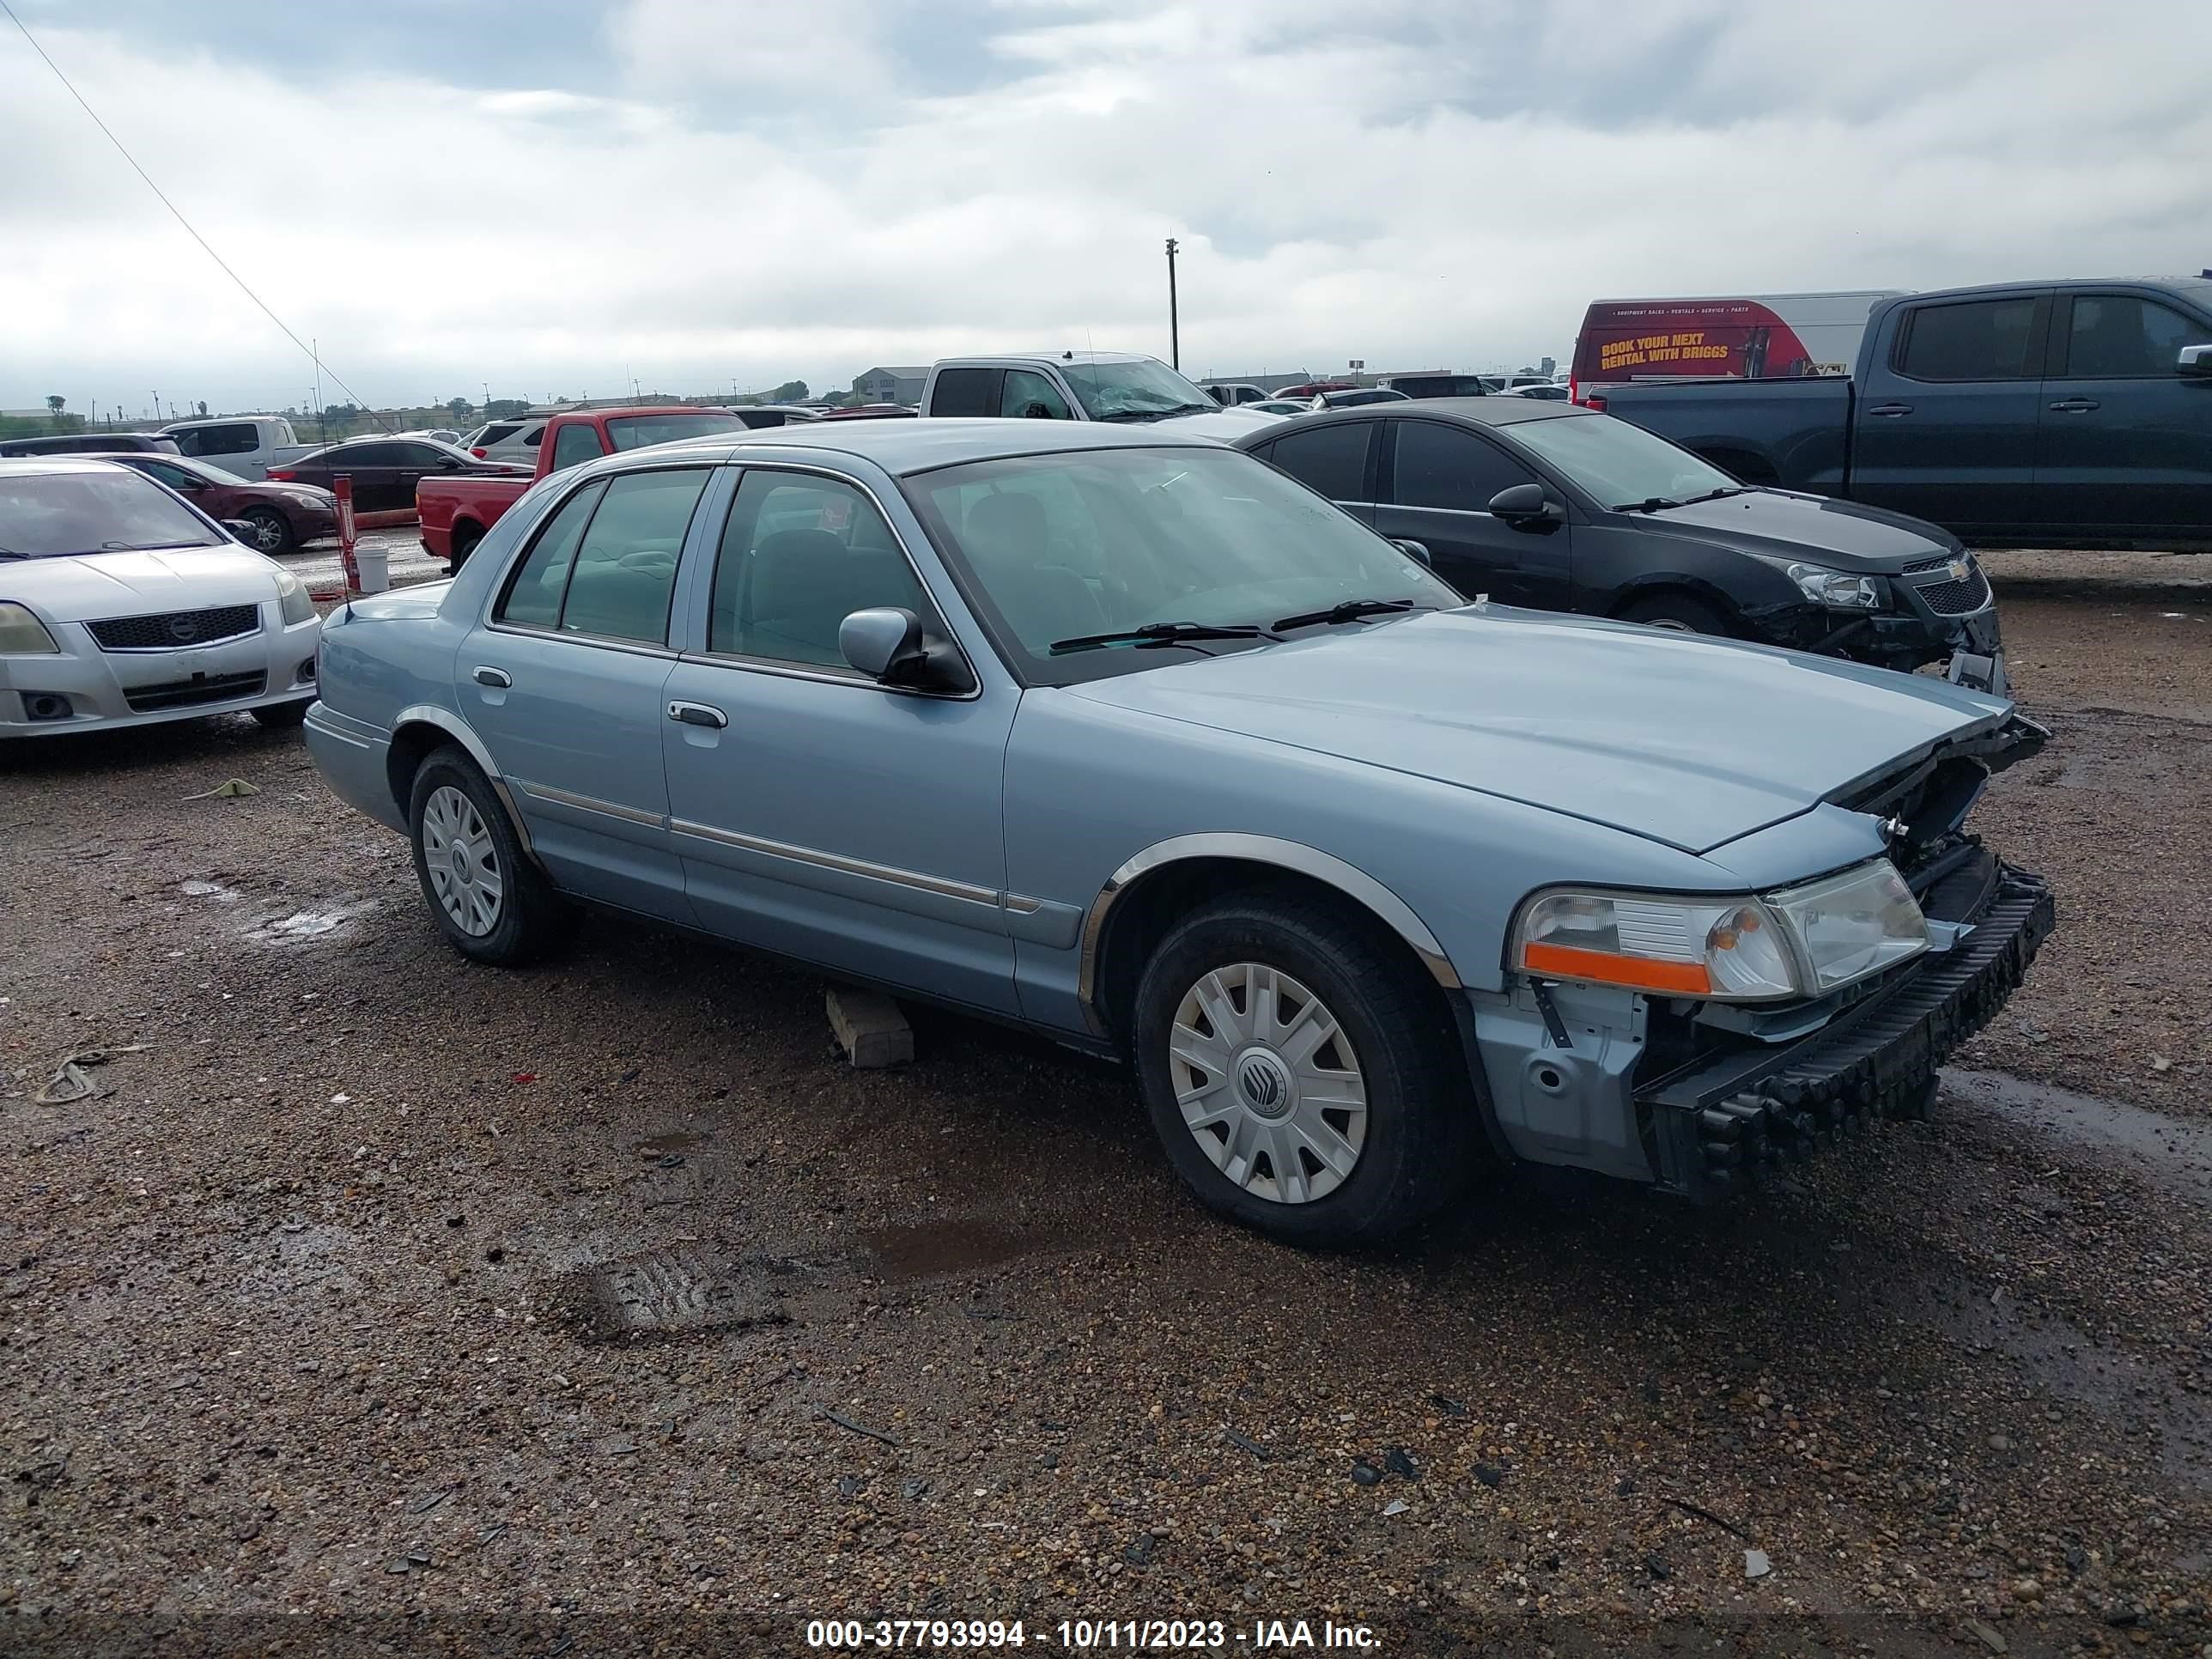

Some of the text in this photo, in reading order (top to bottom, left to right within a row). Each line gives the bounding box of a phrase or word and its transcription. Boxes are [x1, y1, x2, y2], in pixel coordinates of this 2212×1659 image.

[1601, 332, 1705, 357] BOOK YOUR NEXT
[1601, 345, 1729, 370] RENTAL WITH BRIGGS
